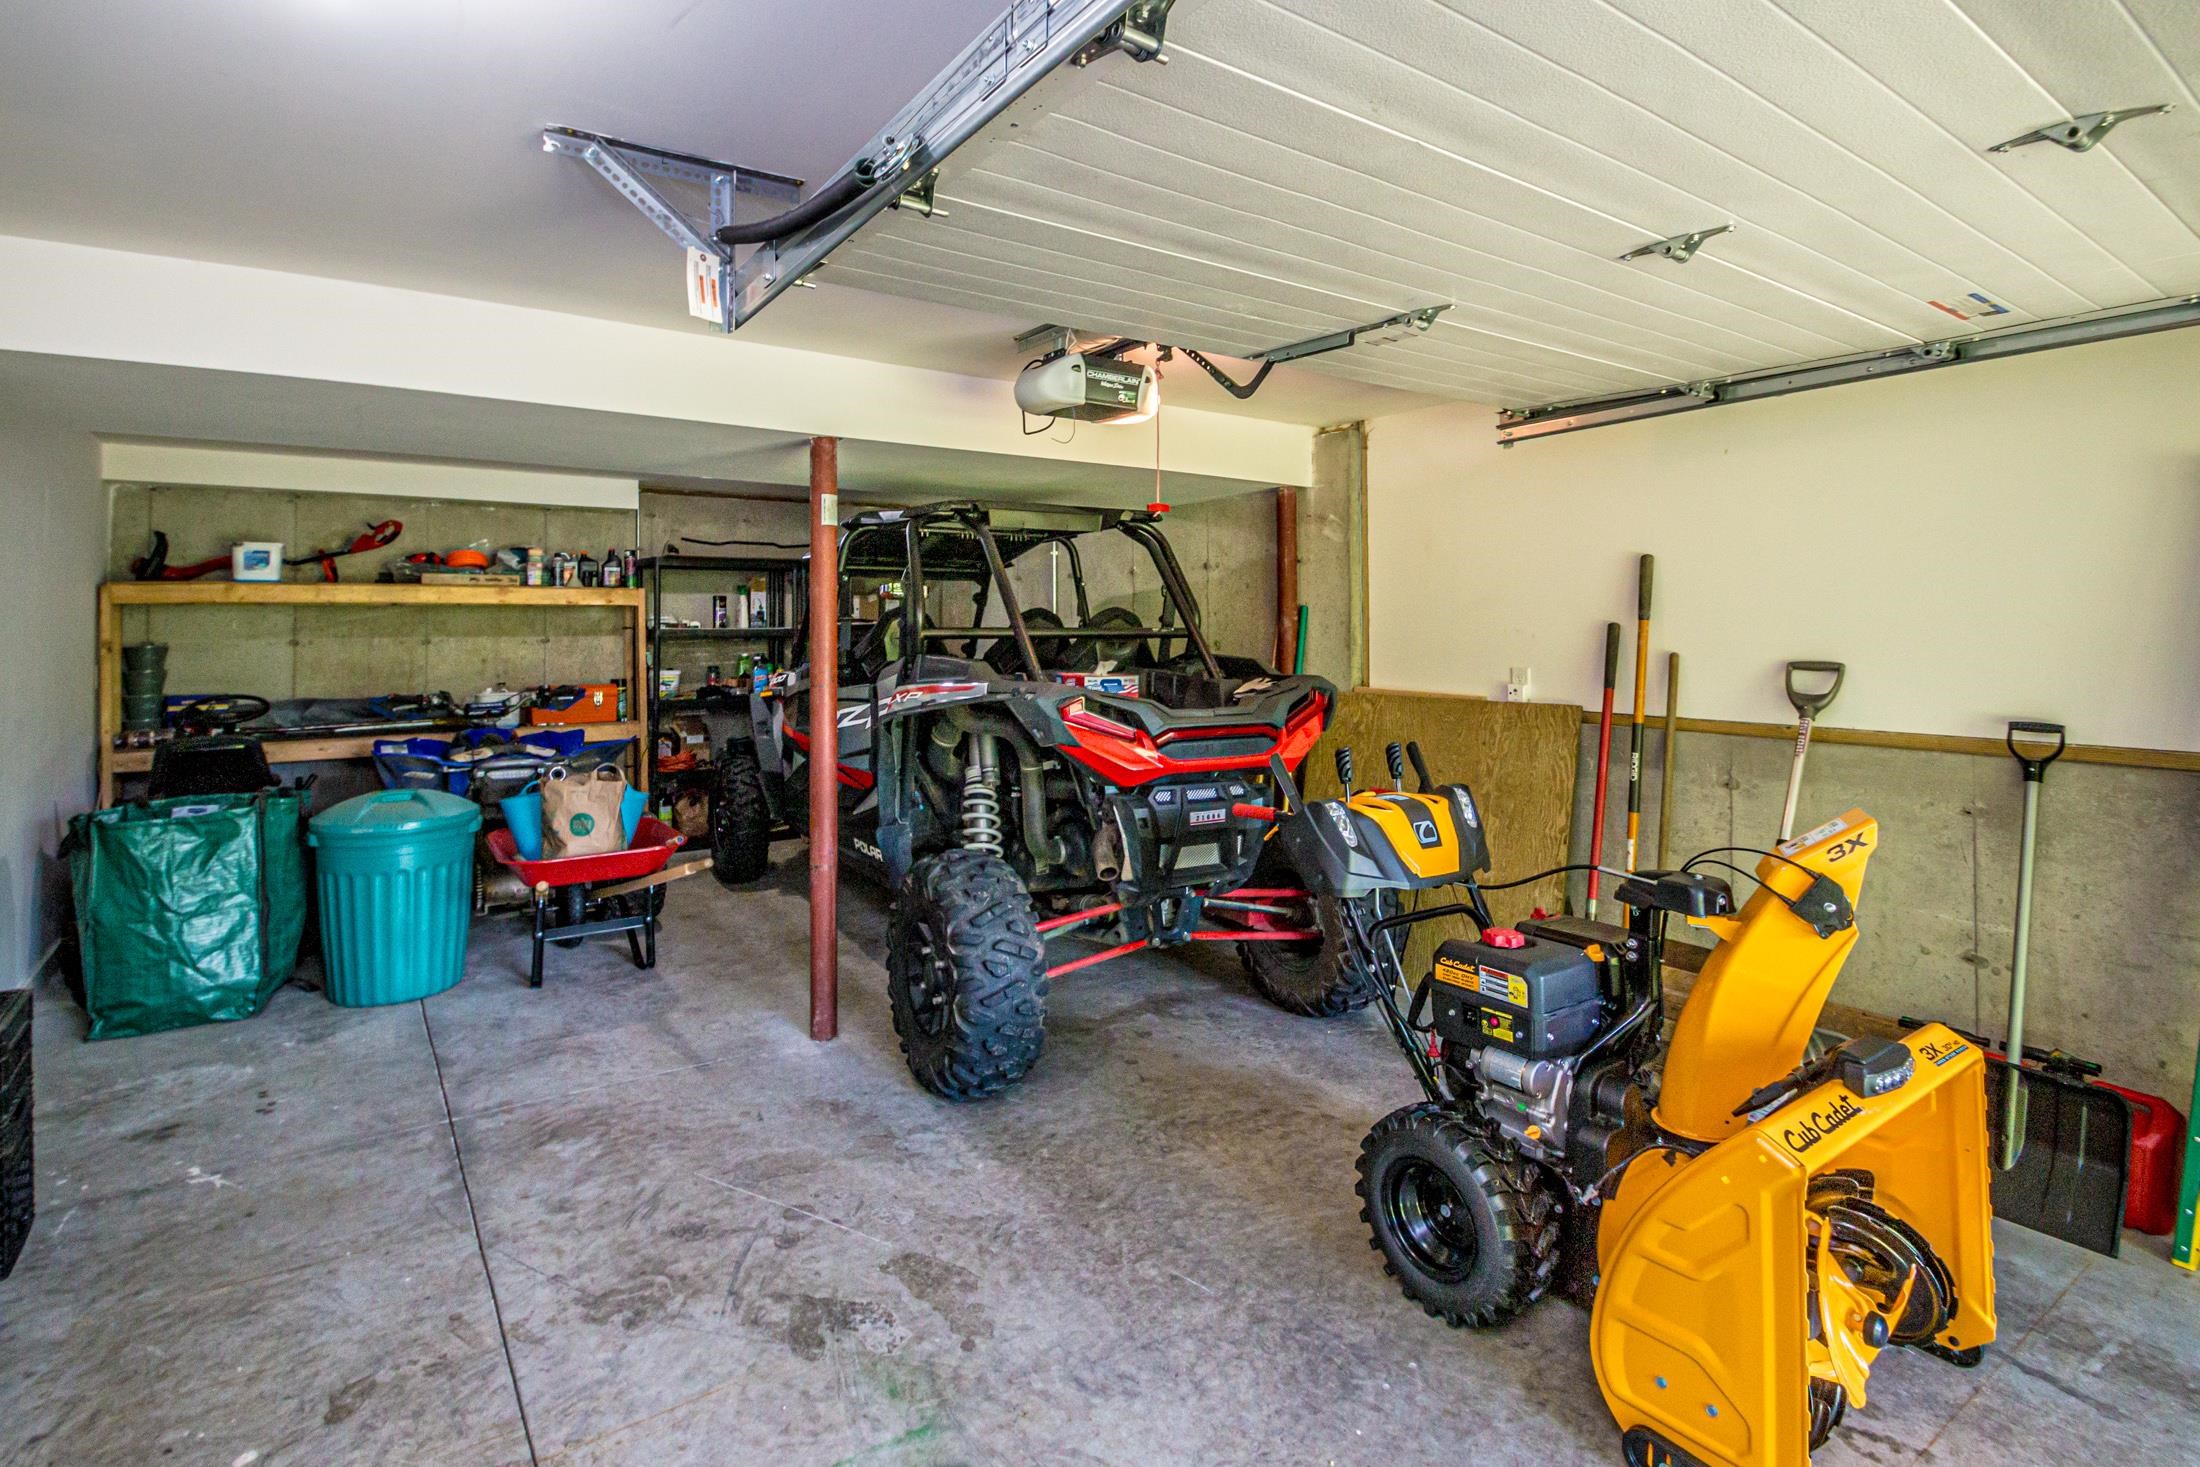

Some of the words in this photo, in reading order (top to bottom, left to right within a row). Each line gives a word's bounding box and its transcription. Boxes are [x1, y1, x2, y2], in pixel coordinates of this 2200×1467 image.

[1087, 369, 1140, 385] CHAMBERLAIN
[891, 691, 923, 704] XP
[1827, 832, 1869, 862] 3X
[1919, 1042, 1943, 1061] 3X
[1783, 1121, 1822, 1153] Cub
[1811, 1094, 1863, 1134] Cadet
